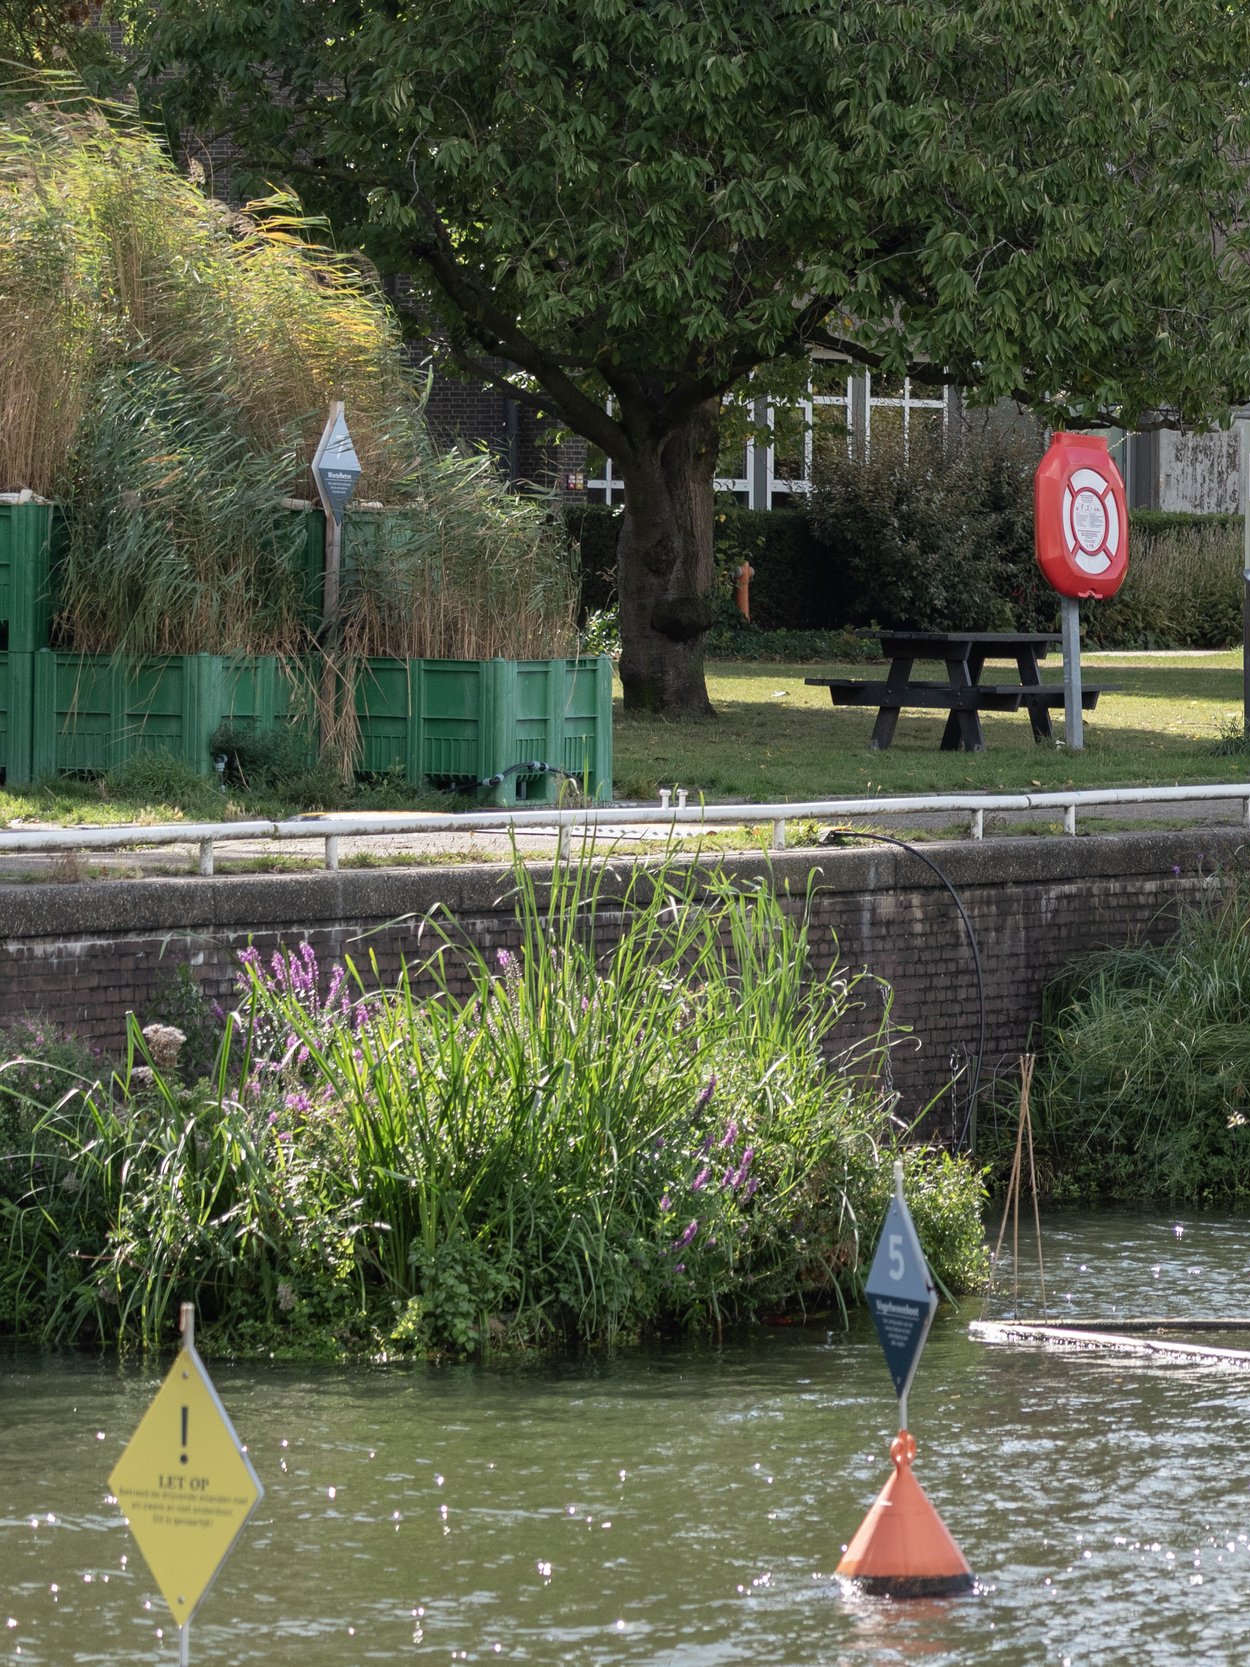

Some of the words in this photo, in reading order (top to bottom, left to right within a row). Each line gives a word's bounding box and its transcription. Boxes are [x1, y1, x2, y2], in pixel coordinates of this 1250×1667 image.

[889, 1234, 905, 1281] 5
[159, 1475, 185, 1489] LET
[189, 1476, 210, 1491] OP
